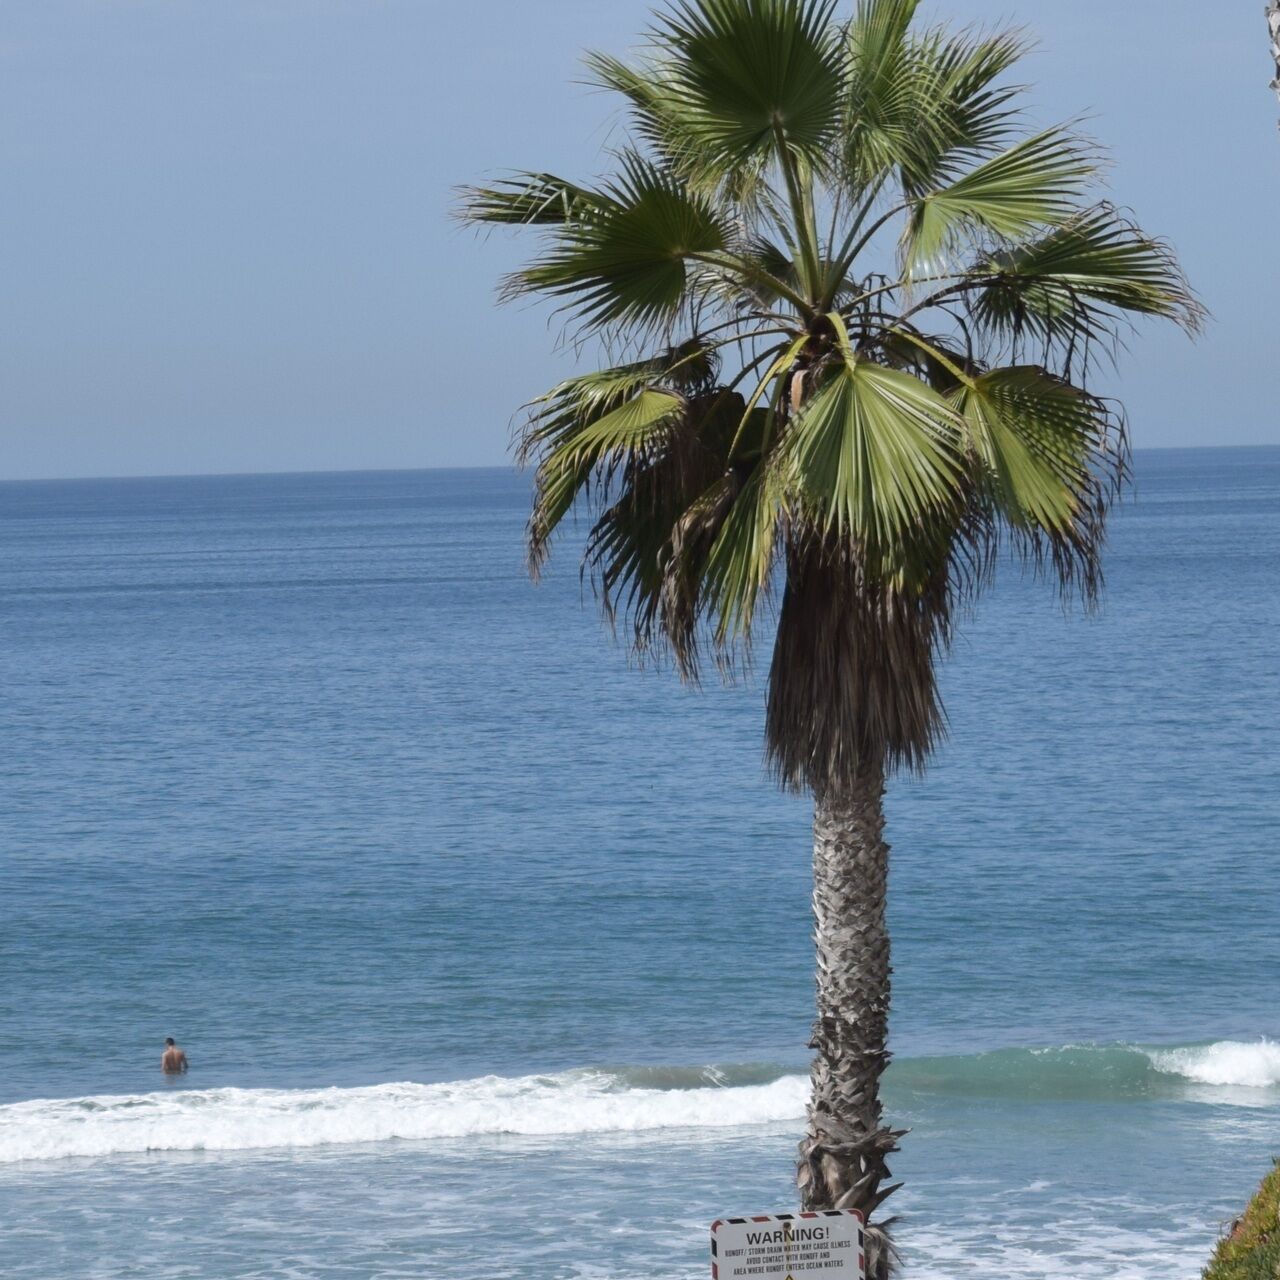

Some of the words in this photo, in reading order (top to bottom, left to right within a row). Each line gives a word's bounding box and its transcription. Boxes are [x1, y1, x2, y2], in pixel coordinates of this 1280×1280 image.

[746, 1226, 829, 1245] WARNING!
[767, 1246, 782, 1254] DRAIN
[814, 1242, 829, 1250] CAUSE
[746, 1256, 760, 1264] AVOID
[762, 1255, 784, 1264] CONTACT
[748, 1266, 764, 1274] WHERE
[786, 1263, 804, 1271] ENTERS
[824, 1260, 843, 1268] WATERS
